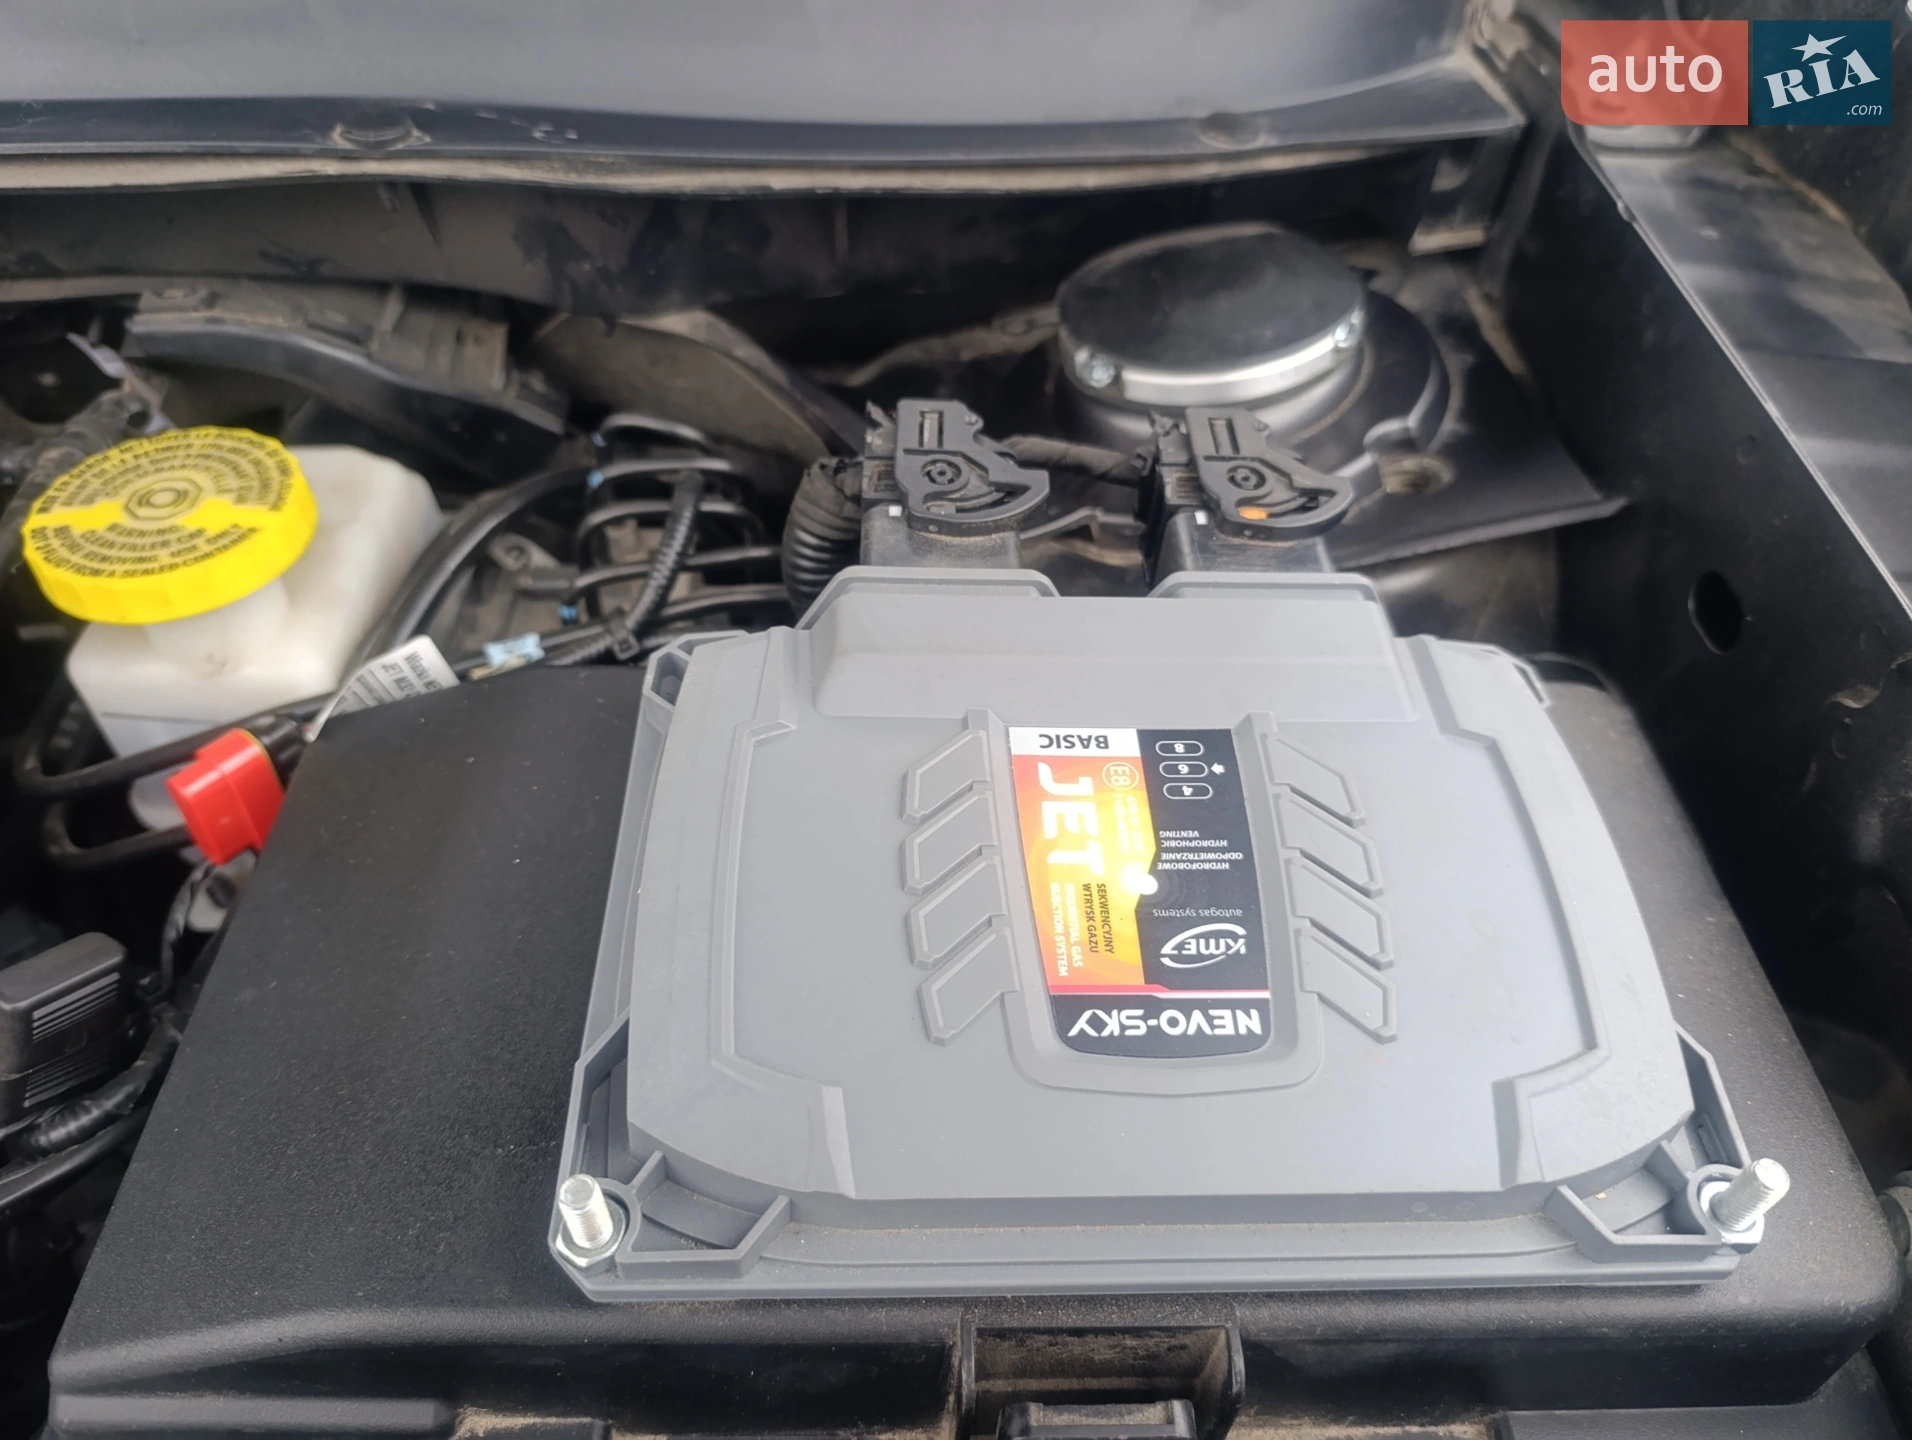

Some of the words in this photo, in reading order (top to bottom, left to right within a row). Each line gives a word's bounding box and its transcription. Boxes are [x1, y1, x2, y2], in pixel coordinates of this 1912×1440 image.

[1039, 734, 1109, 749] BASIC
[1173, 743, 1185, 753] 8
[1109, 765, 1131, 787] E8
[1178, 764, 1189, 774] 6
[1182, 786, 1193, 796] 4
[1037, 761, 1105, 876] JET
[1159, 830, 1199, 838] VENTING
[1160, 839, 1228, 848] HYDROPHOBIC
[1160, 852, 1244, 860] ODPOWIETRZANIE
[1157, 862, 1230, 870] HYDROFOBOWE
[1082, 883, 1096, 923] WTRYSK
[1096, 883, 1115, 955] SEKWENCYJNY
[1152, 908, 1197, 917] systems
[1198, 908, 1243, 917] autogas
[1086, 924, 1099, 954] GAZU
[1185, 938, 1248, 955] KME
[1054, 933, 1069, 977] SYSTEM
[1070, 945, 1084, 968] GAS
[1067, 1008, 1263, 1037] NEVO-SKY
